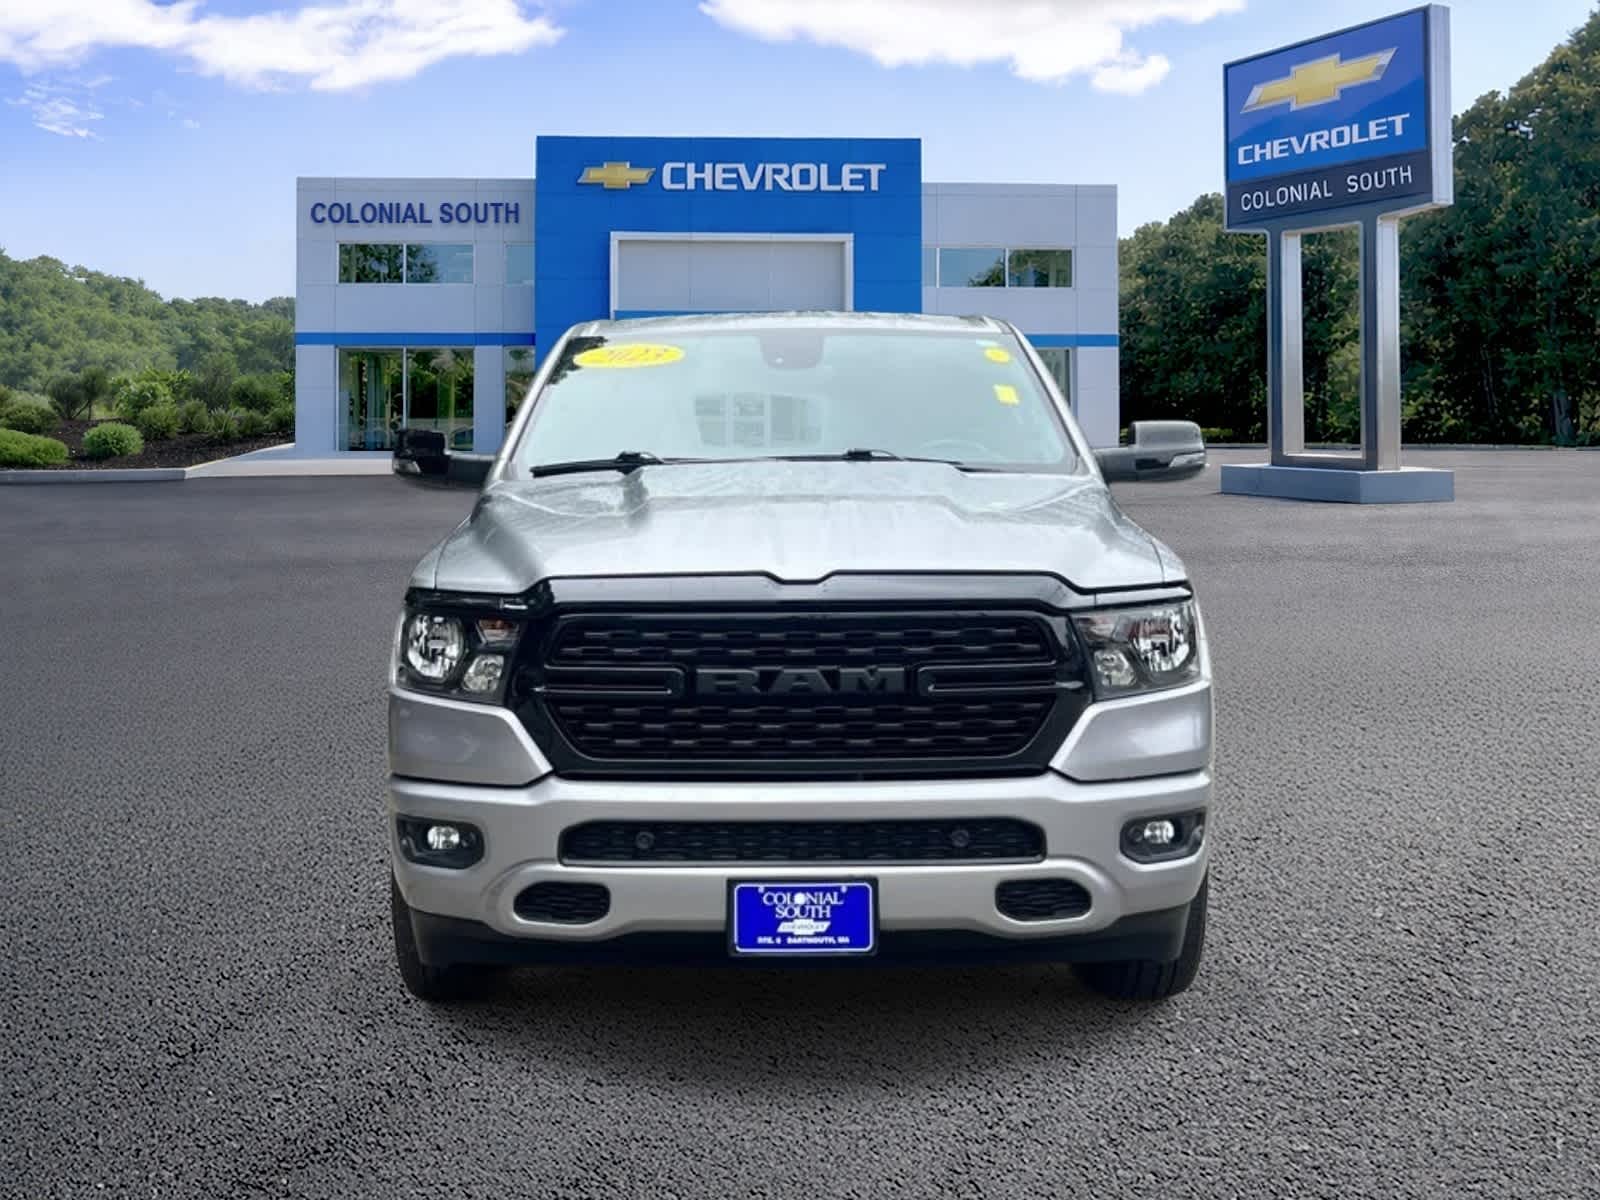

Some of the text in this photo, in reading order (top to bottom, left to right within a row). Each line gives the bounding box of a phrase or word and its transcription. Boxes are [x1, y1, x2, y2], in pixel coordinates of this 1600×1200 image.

[1237, 113, 1410, 165] CHEVROLET
[662, 161, 887, 192] CHEVROLET
[1240, 165, 1412, 212] COLONIAL SOUTH
[310, 202, 520, 224] COLONIAL SOUTH
[696, 667, 905, 694] RAM
[762, 892, 844, 905] COLONIAL
[775, 905, 831, 918] SOUTH
